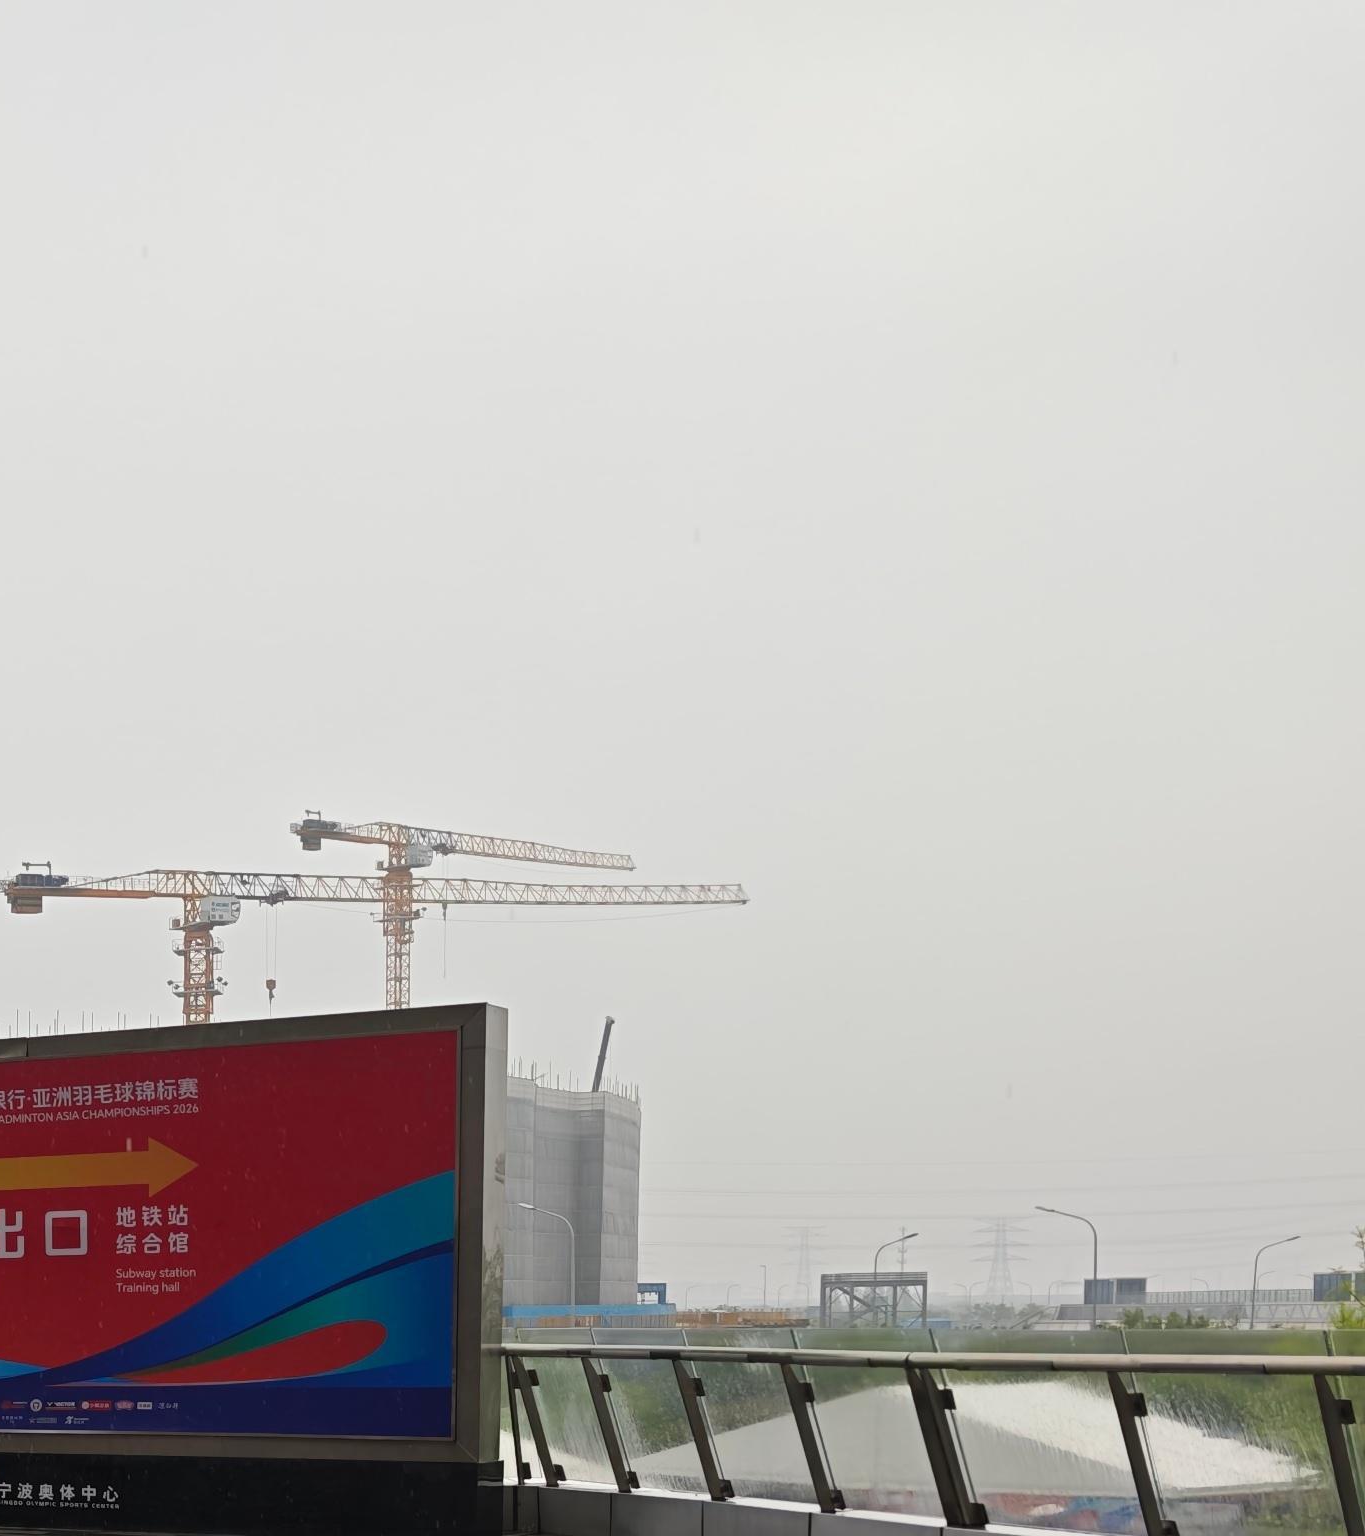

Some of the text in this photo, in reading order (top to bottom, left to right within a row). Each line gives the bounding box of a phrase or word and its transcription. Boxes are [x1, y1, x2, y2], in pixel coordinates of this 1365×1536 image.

[55, 1110, 80, 1121] ASIA
[81, 1104, 171, 1120] CHAMPIONSHIPS
[172, 1103, 199, 1114] 2026
[115, 1204, 189, 1228] 地铁站
[115, 1232, 189, 1255] 综合馆
[115, 1267, 197, 1281] Subway station
[115, 1281, 181, 1295] Training hall
[59, 1501, 89, 1509] SPORTS
